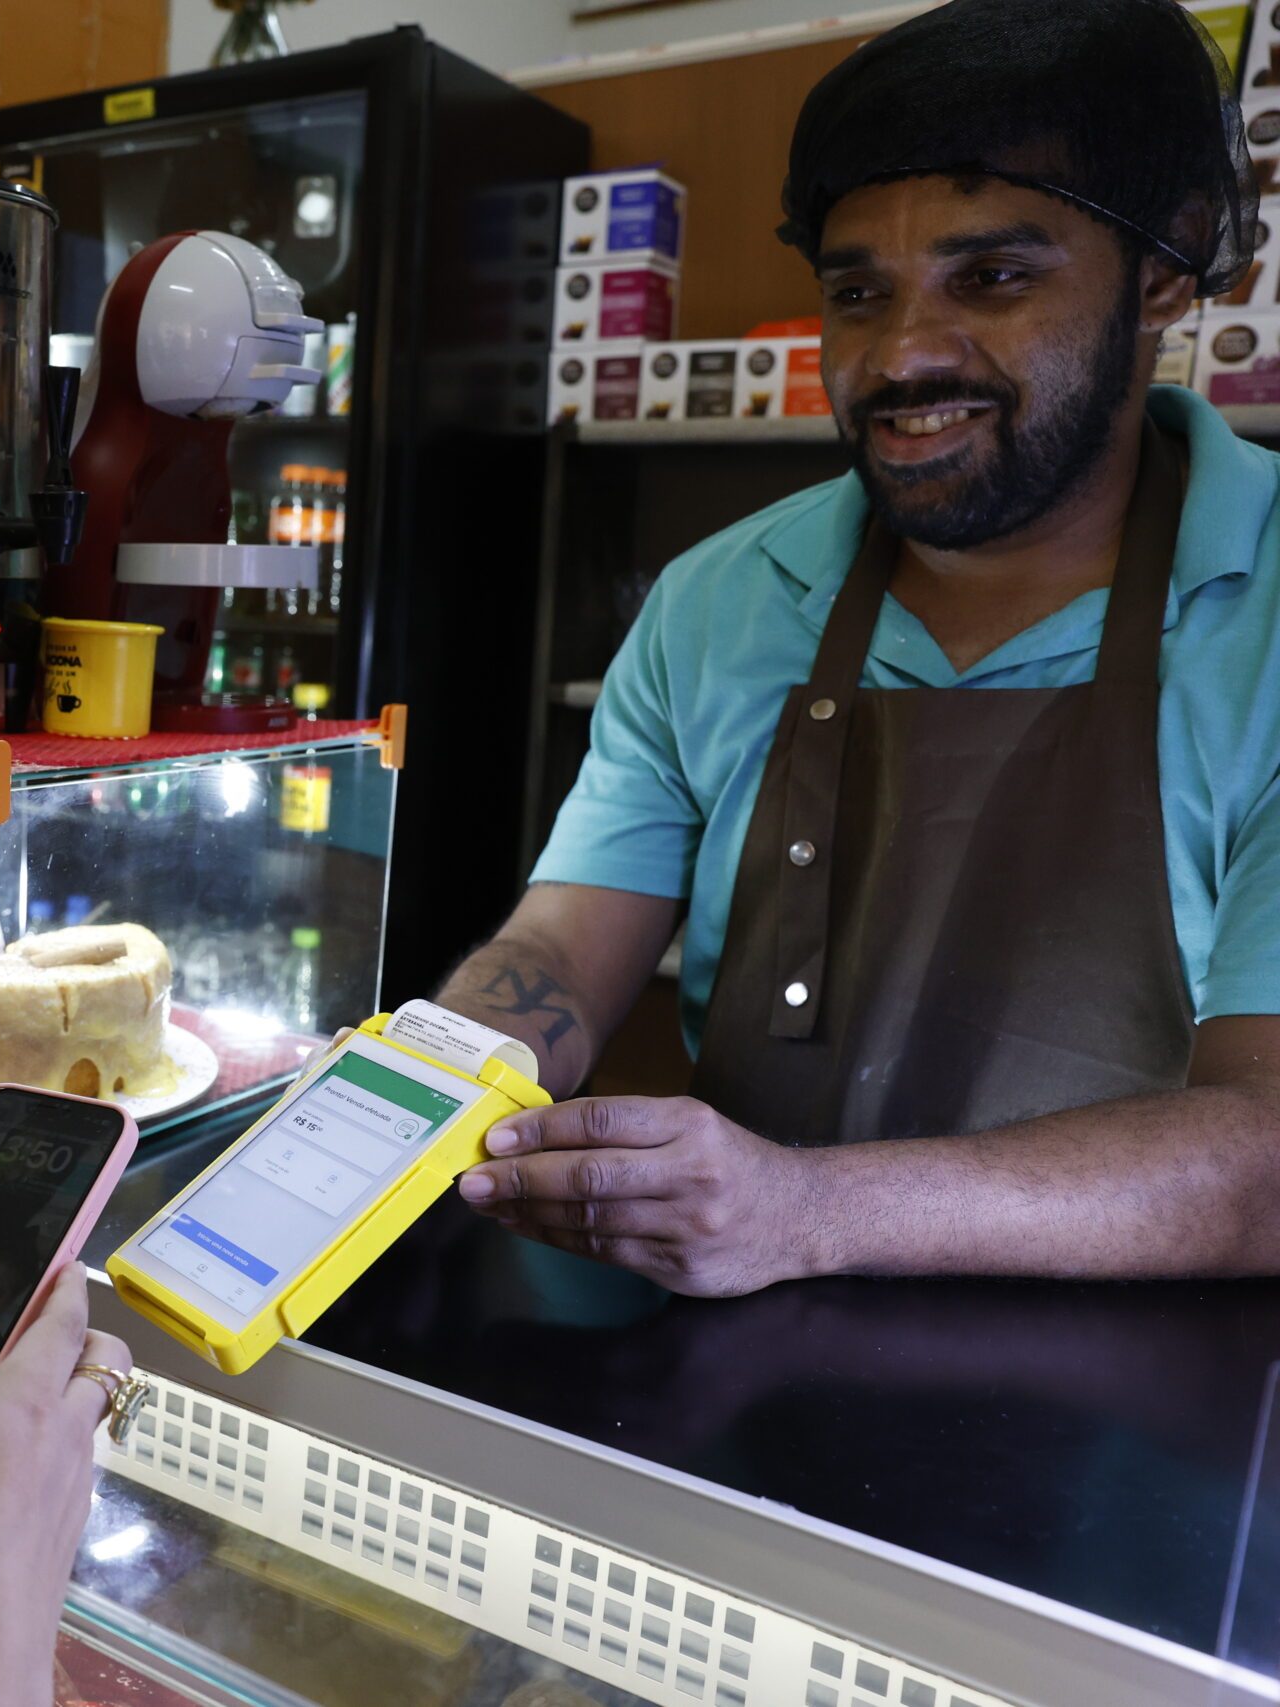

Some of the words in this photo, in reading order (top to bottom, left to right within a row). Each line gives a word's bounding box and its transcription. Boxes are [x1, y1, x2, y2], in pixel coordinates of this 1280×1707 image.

[324, 1086, 346, 1099] Pronto!
[346, 1096, 365, 1109] Venda
[365, 1105, 392, 1122] efetuada
[292, 1115, 308, 1127] R$
